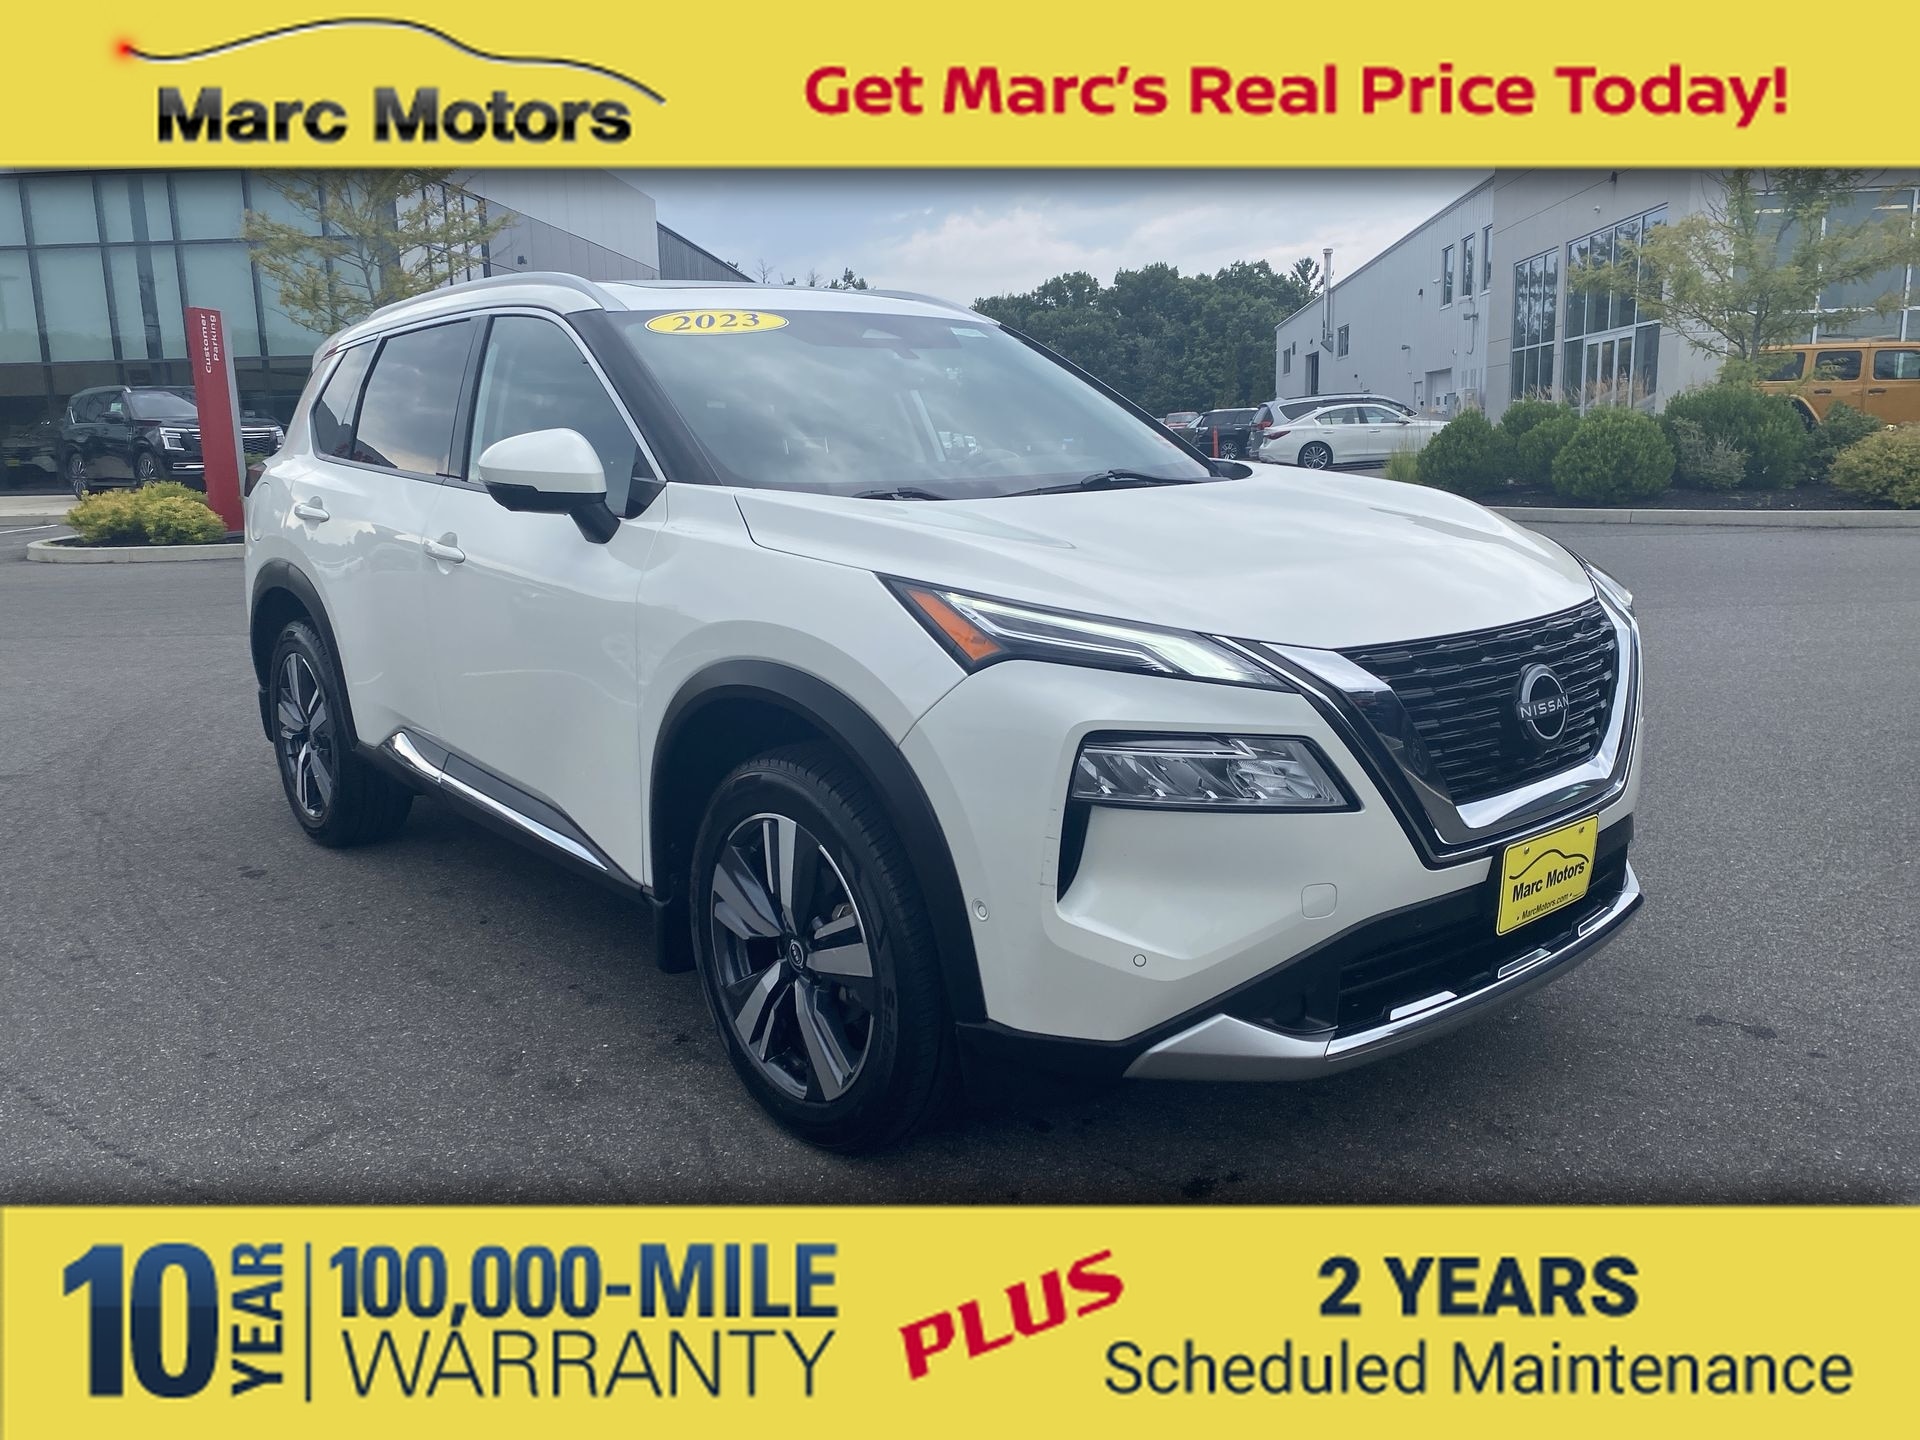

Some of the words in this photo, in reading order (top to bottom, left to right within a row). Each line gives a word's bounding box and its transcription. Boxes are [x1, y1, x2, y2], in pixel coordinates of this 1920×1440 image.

[209, 314, 219, 361] Parking
[672, 313, 760, 331] 2023
[200, 313, 212, 373] Customer
[1520, 693, 1569, 719] NISSAN
[1512, 879, 1543, 902] Marc
[1546, 861, 1585, 888] Motors
